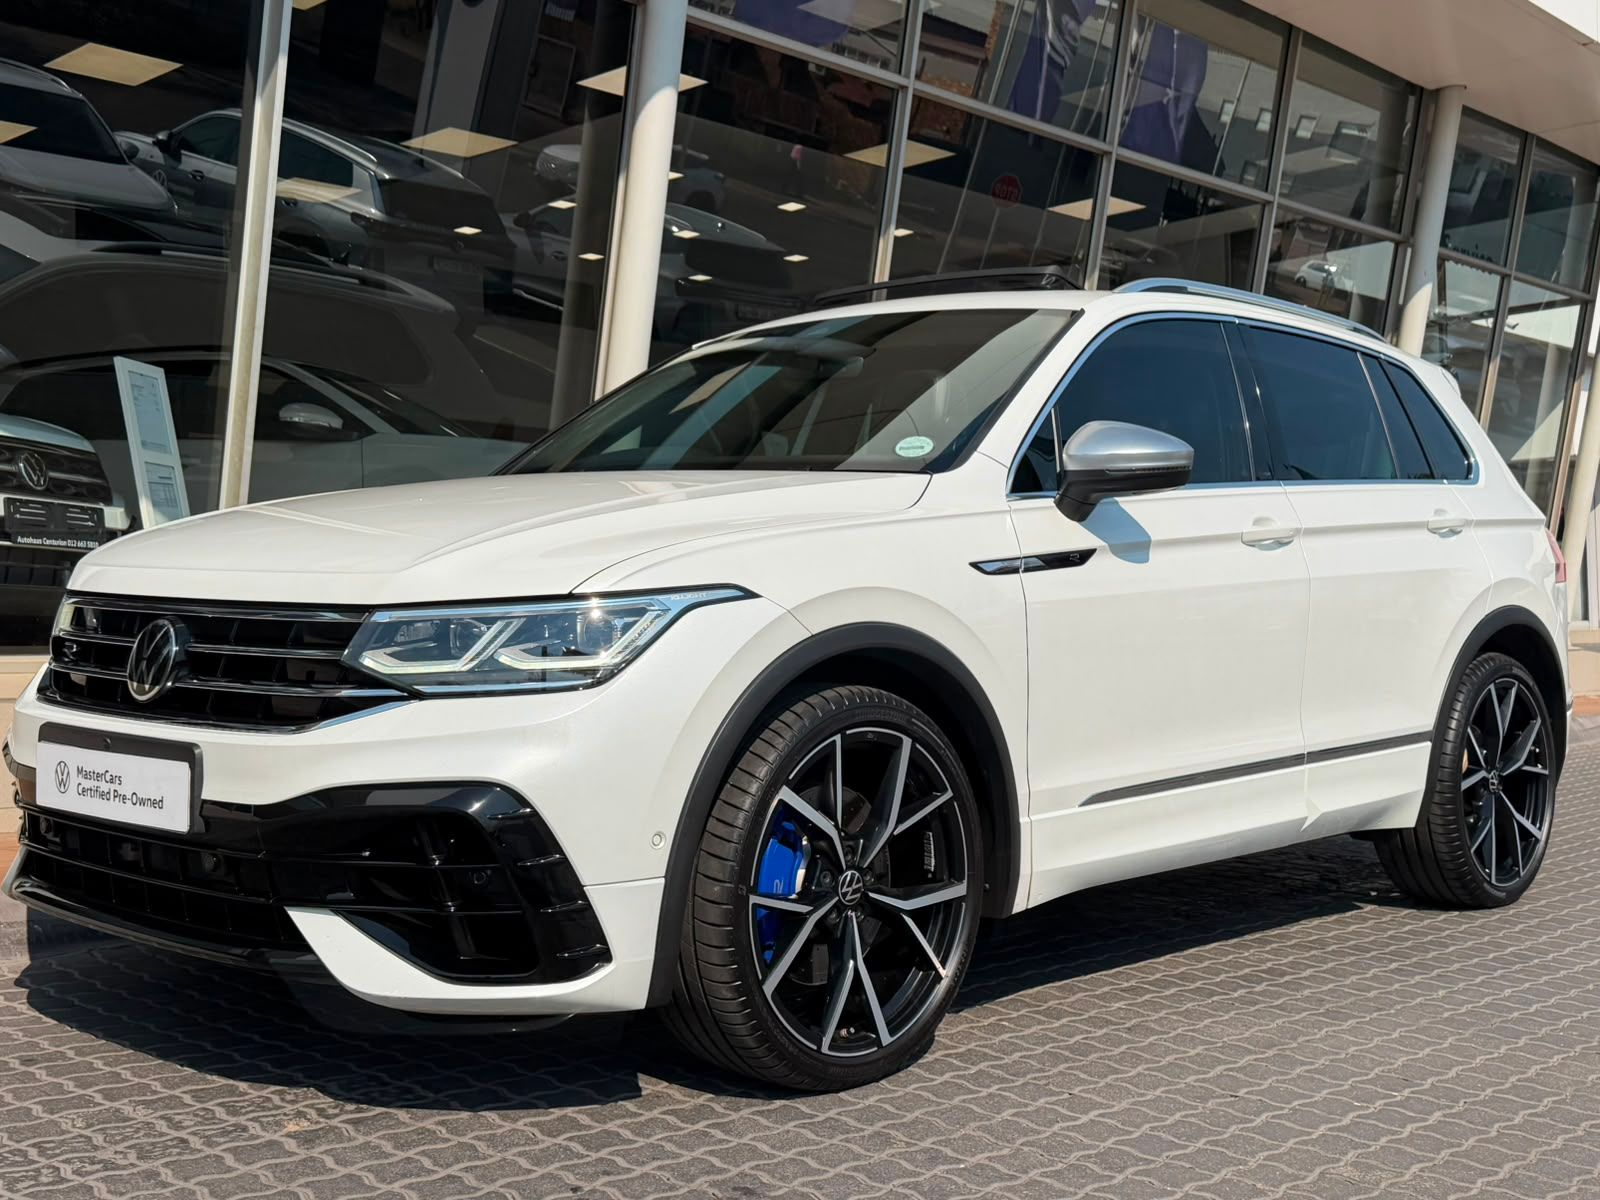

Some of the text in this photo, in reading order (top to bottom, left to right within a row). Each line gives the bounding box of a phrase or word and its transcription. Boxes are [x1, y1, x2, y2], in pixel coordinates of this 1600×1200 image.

[17, 536, 42, 545] Autohaus
[43, 537, 67, 546] Centurion
[77, 765, 123, 786] MasterCars
[77, 783, 164, 810] Certified Pre-Owned
